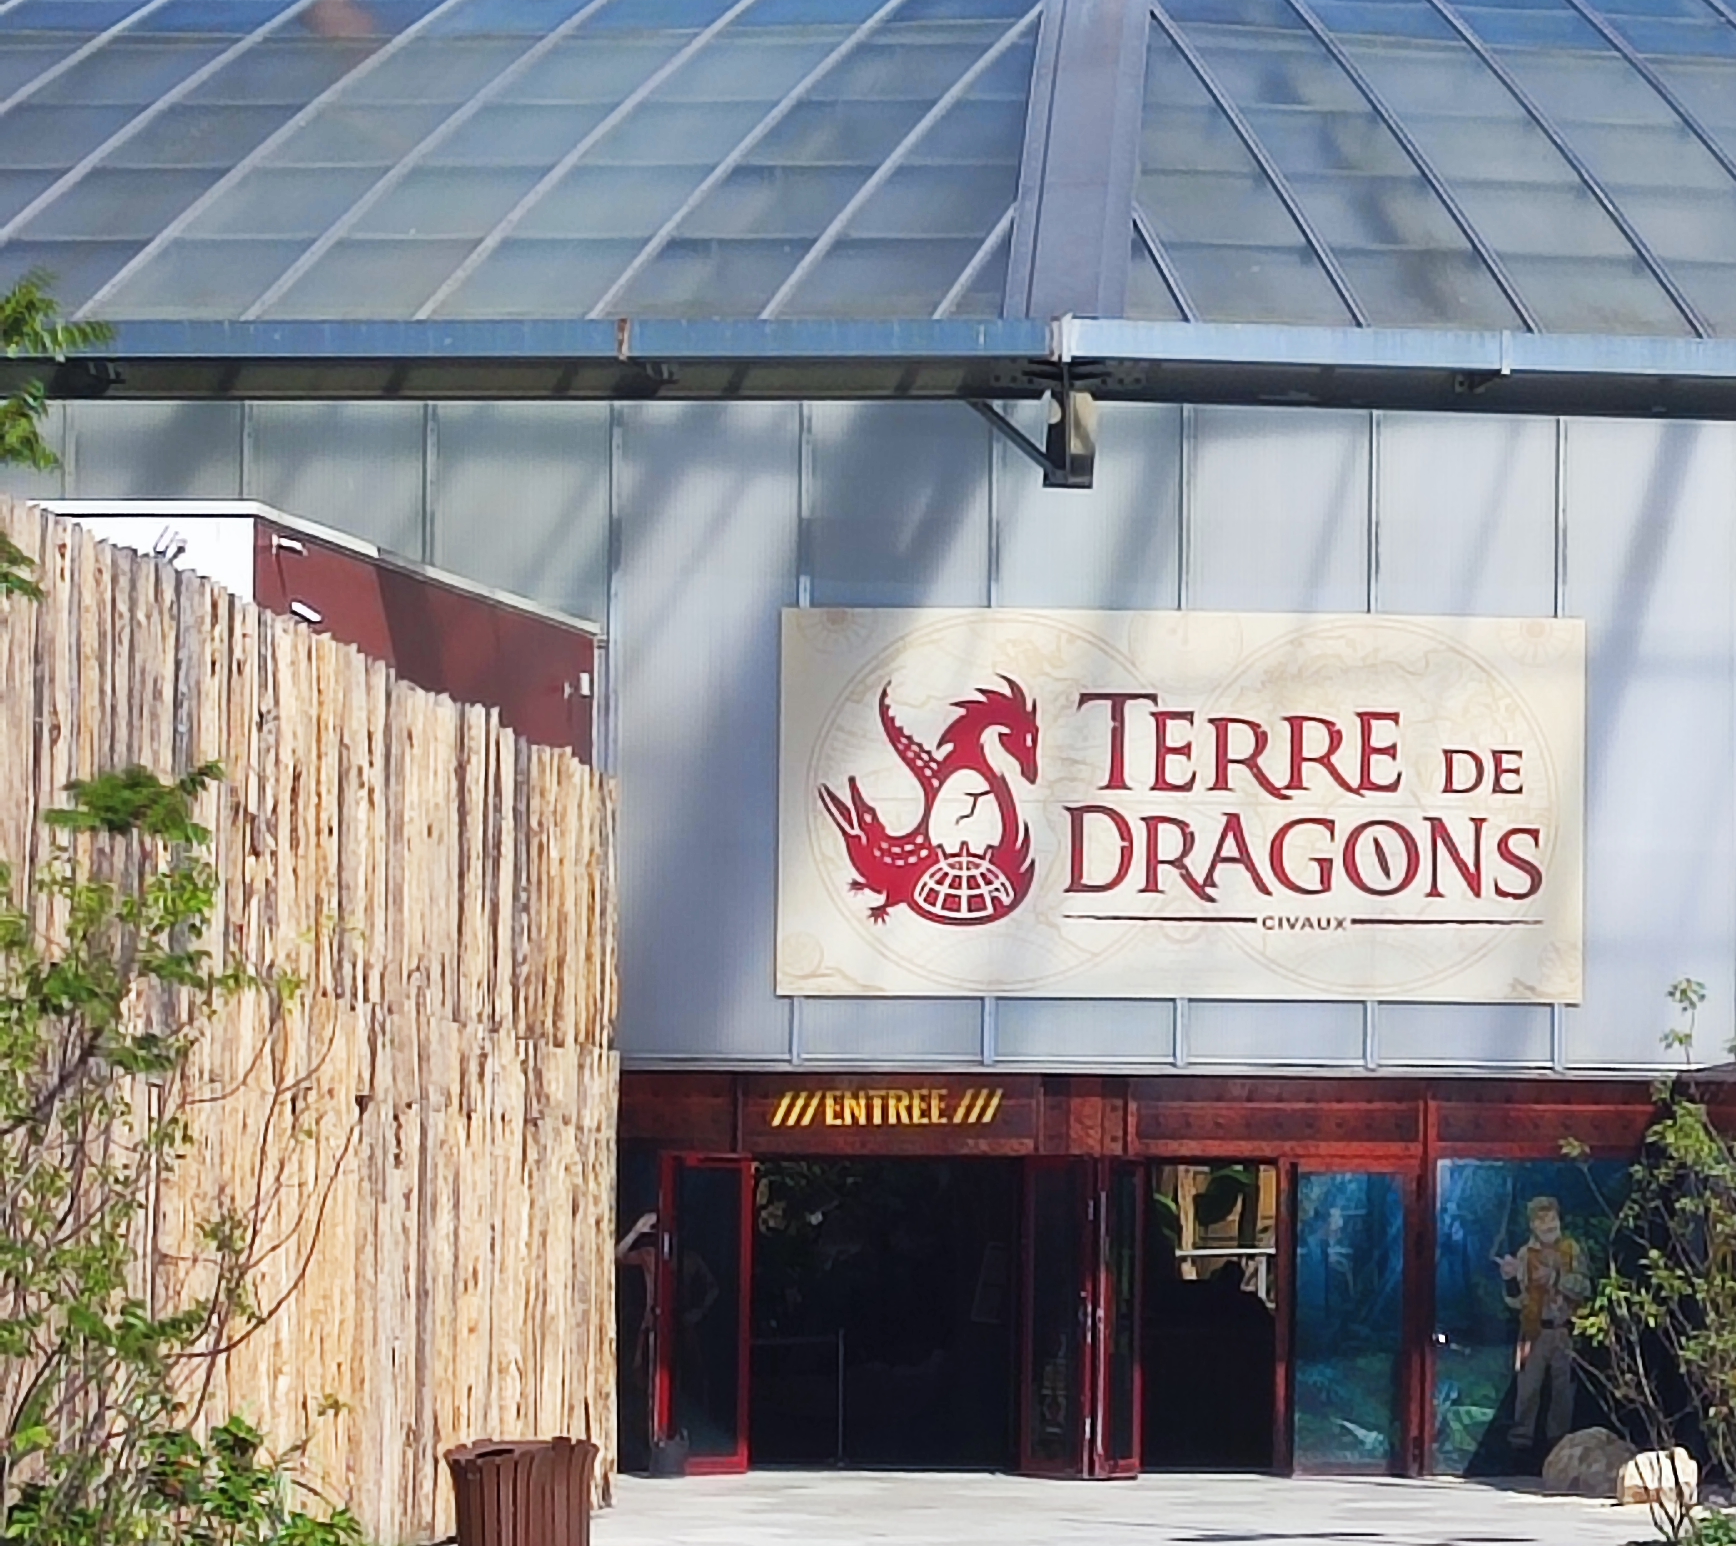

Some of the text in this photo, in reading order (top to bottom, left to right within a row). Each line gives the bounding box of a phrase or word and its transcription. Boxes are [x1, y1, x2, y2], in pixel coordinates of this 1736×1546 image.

[1076, 692, 1525, 800] TERRE DE
[1062, 804, 1544, 903] DRAGONS
[1261, 914, 1348, 932] CIVAUX
